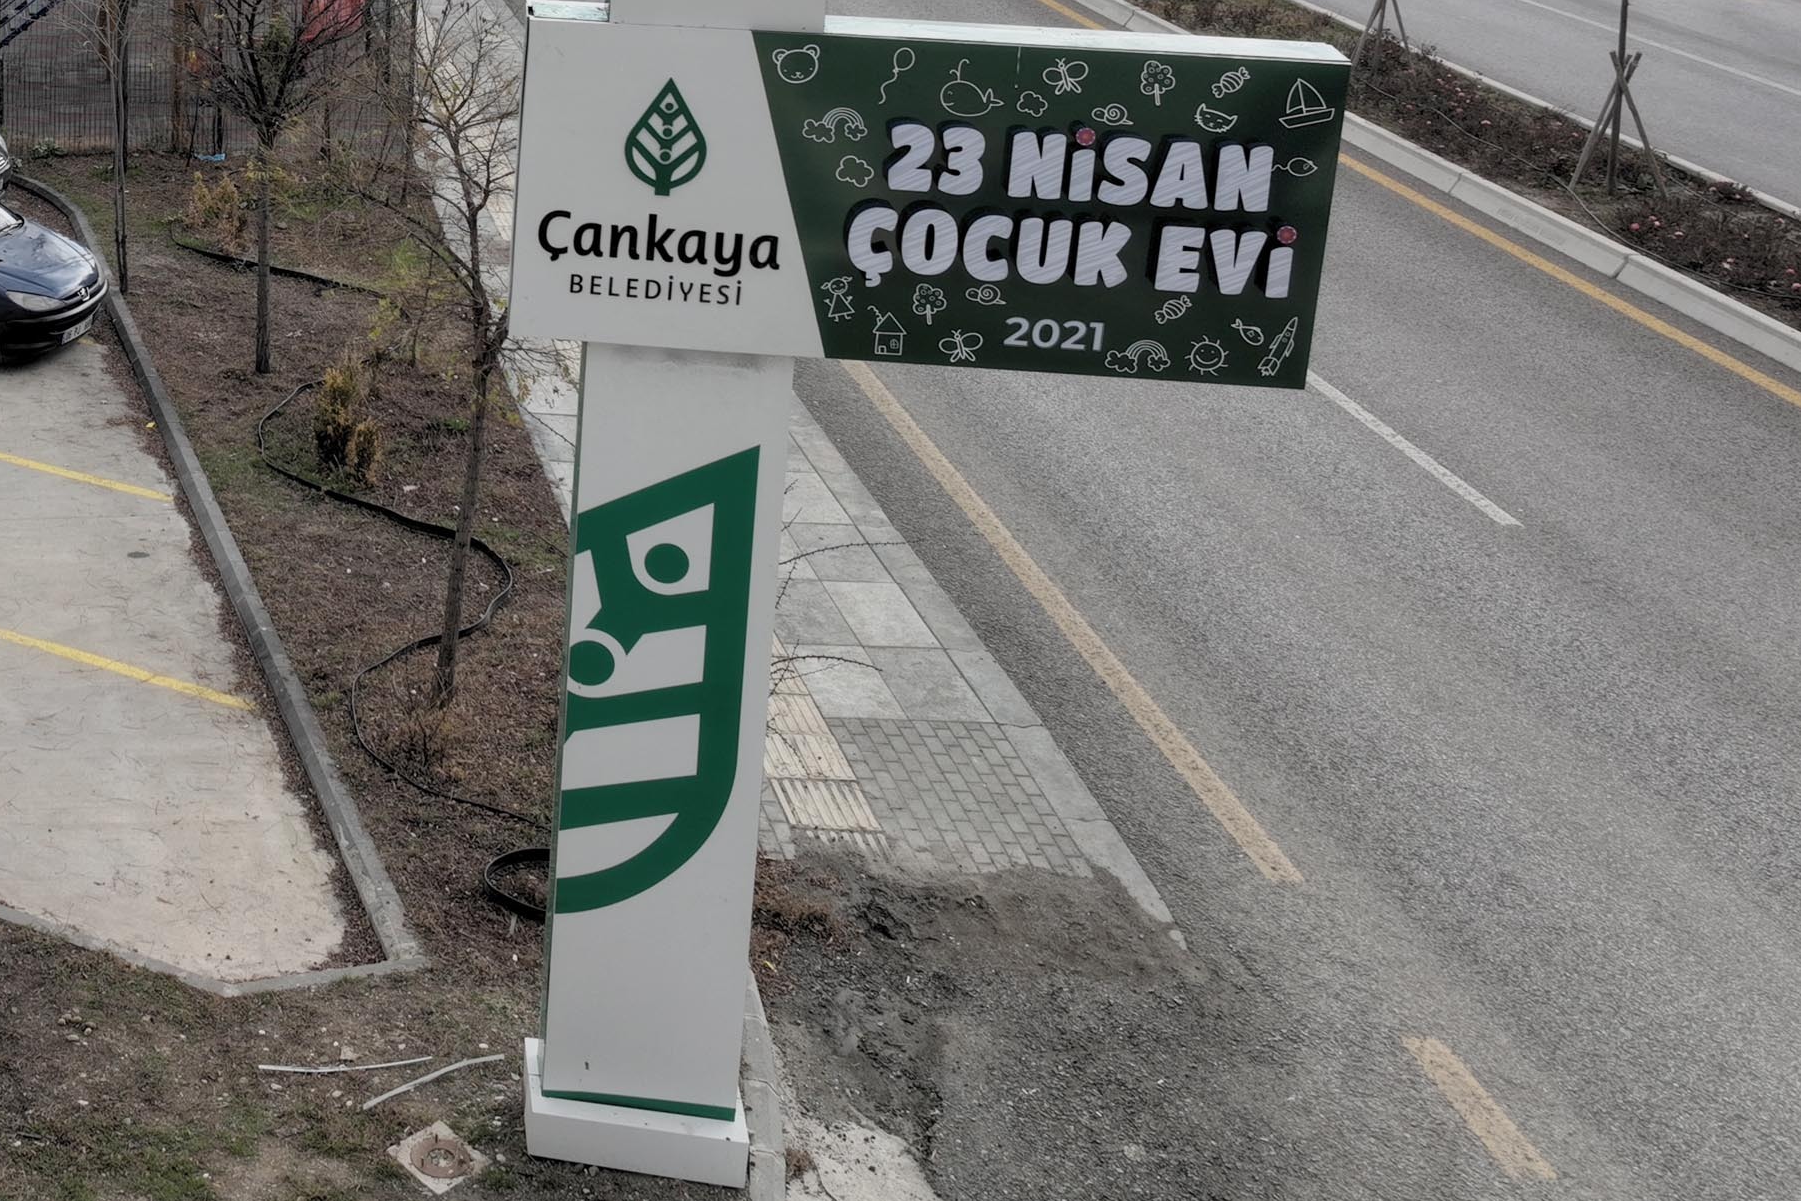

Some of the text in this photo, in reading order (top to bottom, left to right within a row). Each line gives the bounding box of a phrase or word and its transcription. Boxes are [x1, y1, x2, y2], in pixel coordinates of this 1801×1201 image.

[882, 122, 987, 196] 23
[537, 209, 781, 278] Çankaya
[843, 201, 1133, 289] ÇOCUK
[569, 273, 743, 306] BELEDİYESİ
[1002, 315, 1106, 352] 2021
